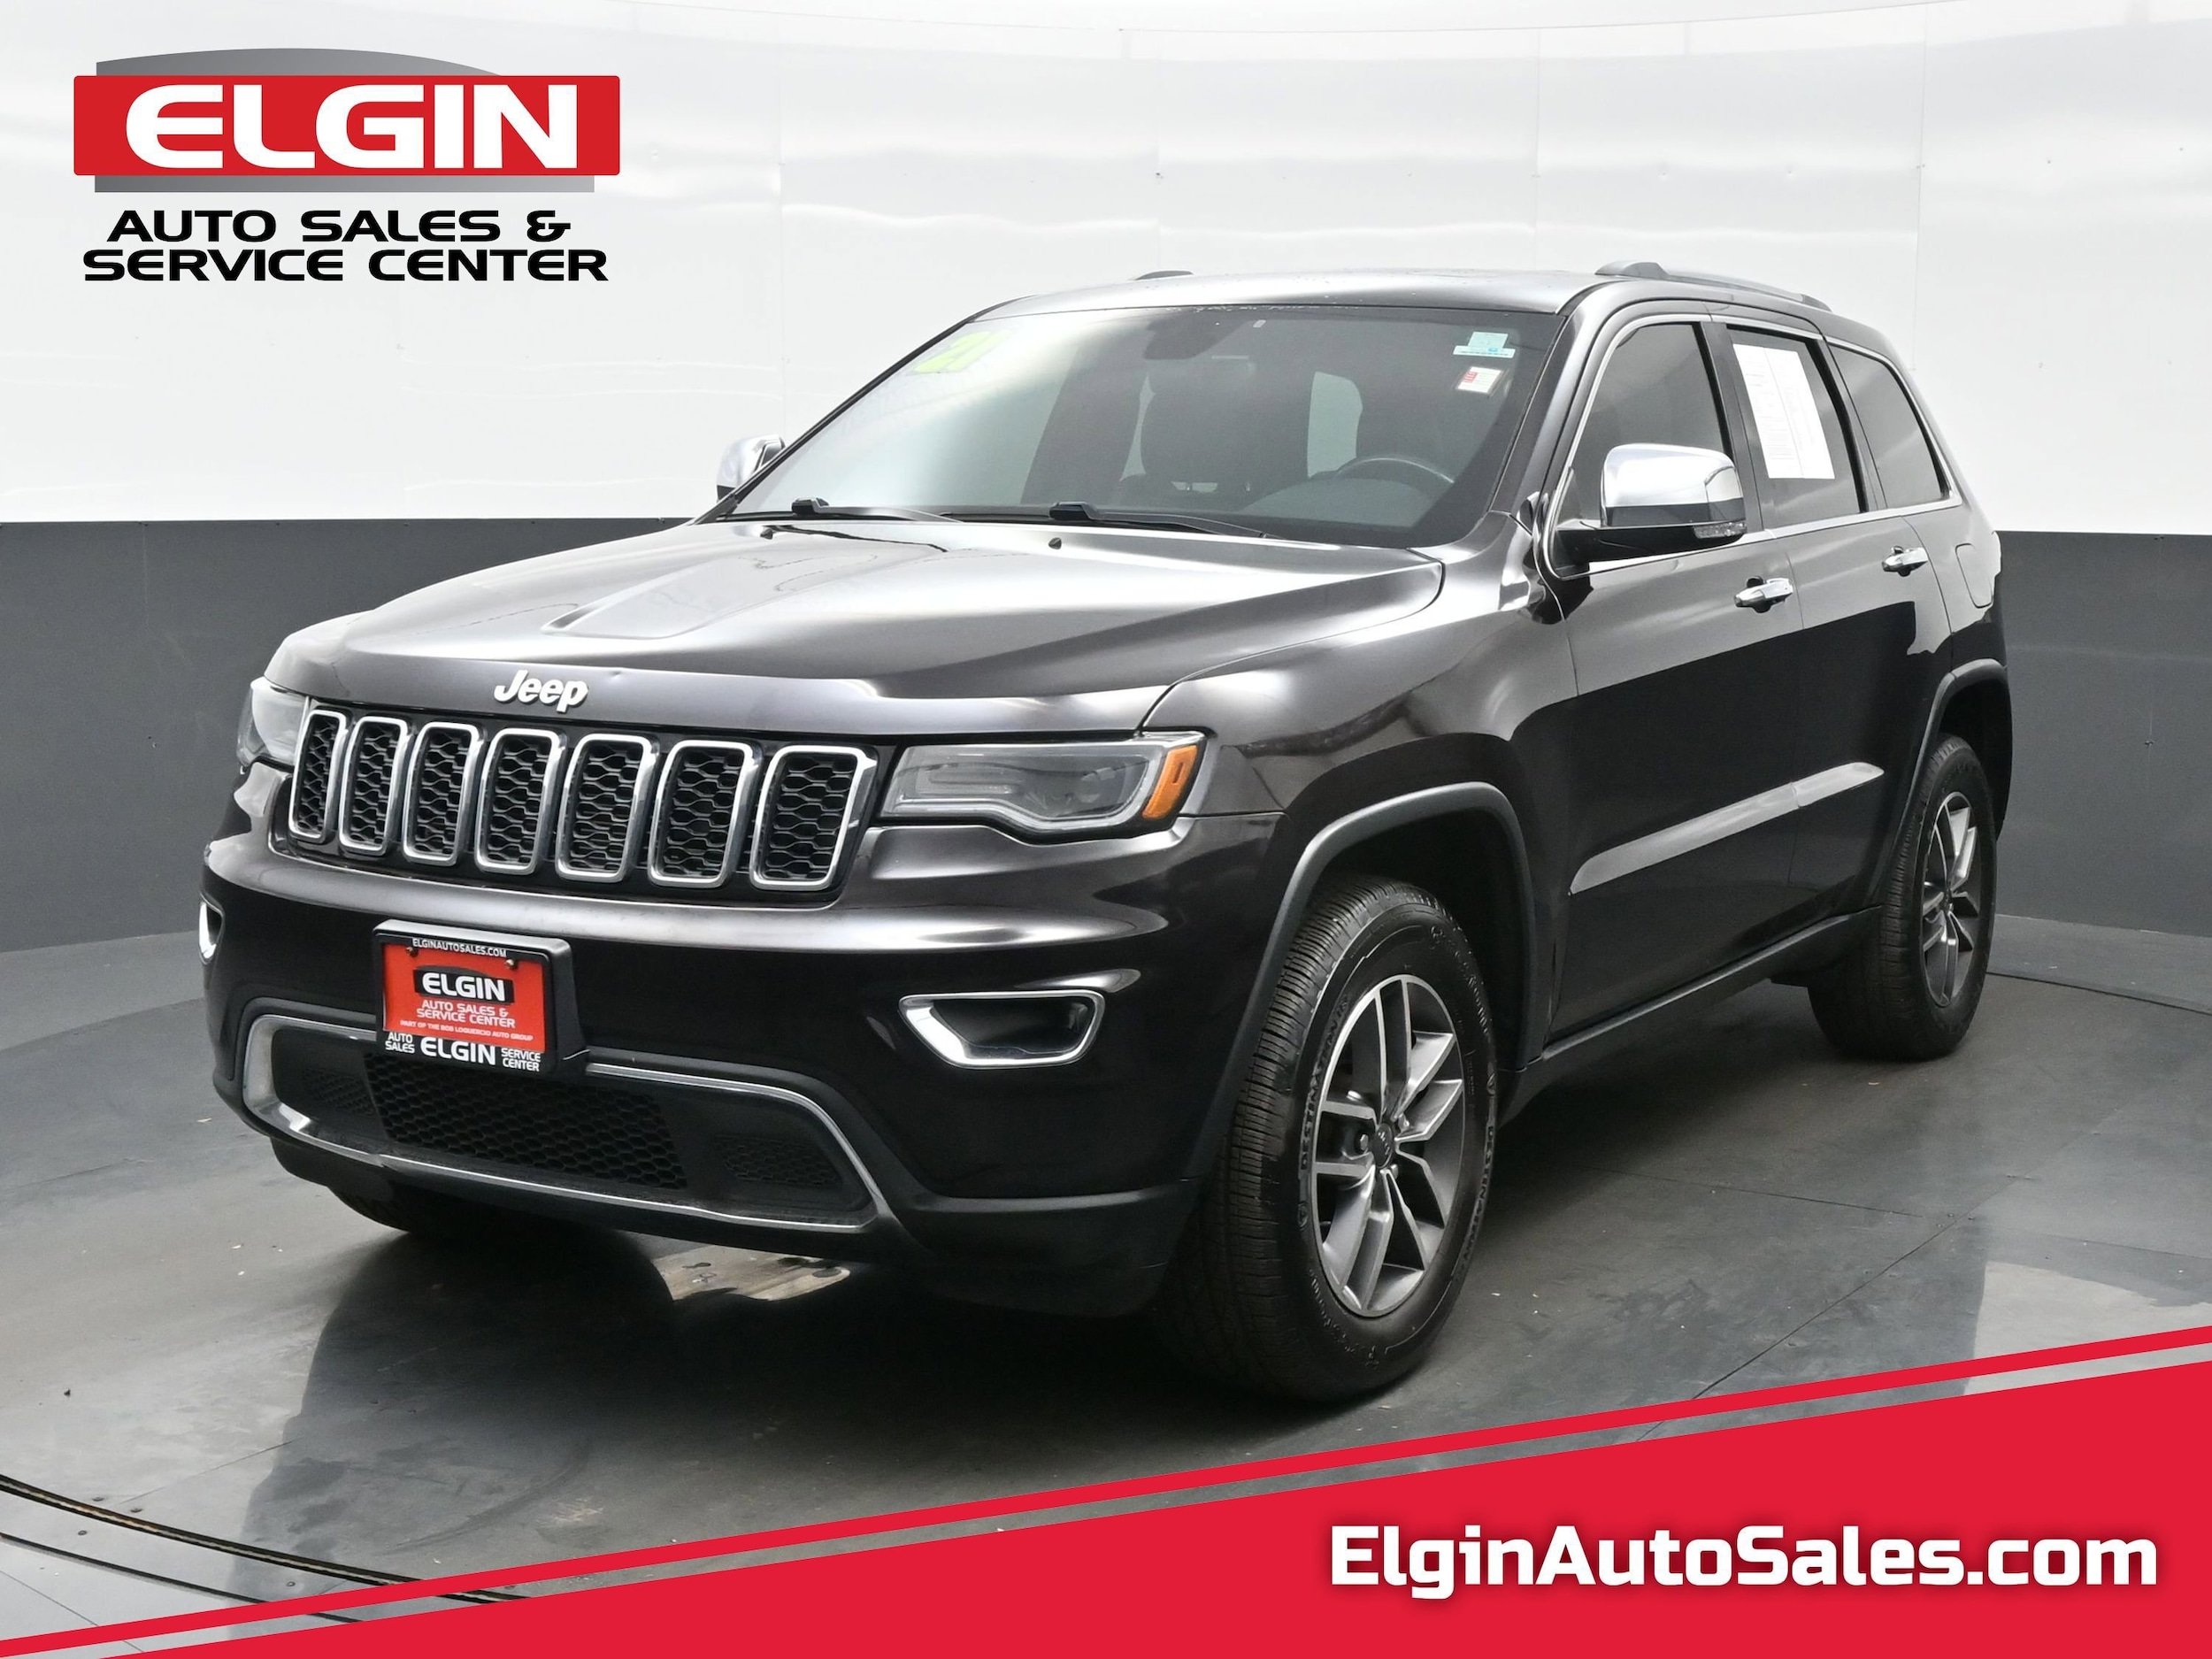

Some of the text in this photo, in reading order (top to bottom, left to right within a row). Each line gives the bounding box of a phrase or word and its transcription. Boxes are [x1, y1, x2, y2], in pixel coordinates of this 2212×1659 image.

[493, 669, 588, 713] Jeep
[412, 938, 507, 957] ELGINAUTOSALES.COM
[422, 972, 505, 1002] ELGIN
[417, 1008, 516, 1028] SERVICE CENTER
[422, 1000, 509, 1018] AUTO SALES &
[388, 1032, 413, 1044] AUTO
[385, 1041, 415, 1054] SALES
[420, 1036, 495, 1065] ELGIN
[501, 1048, 541, 1063] SERVICE
[503, 1058, 540, 1072] CENTER
